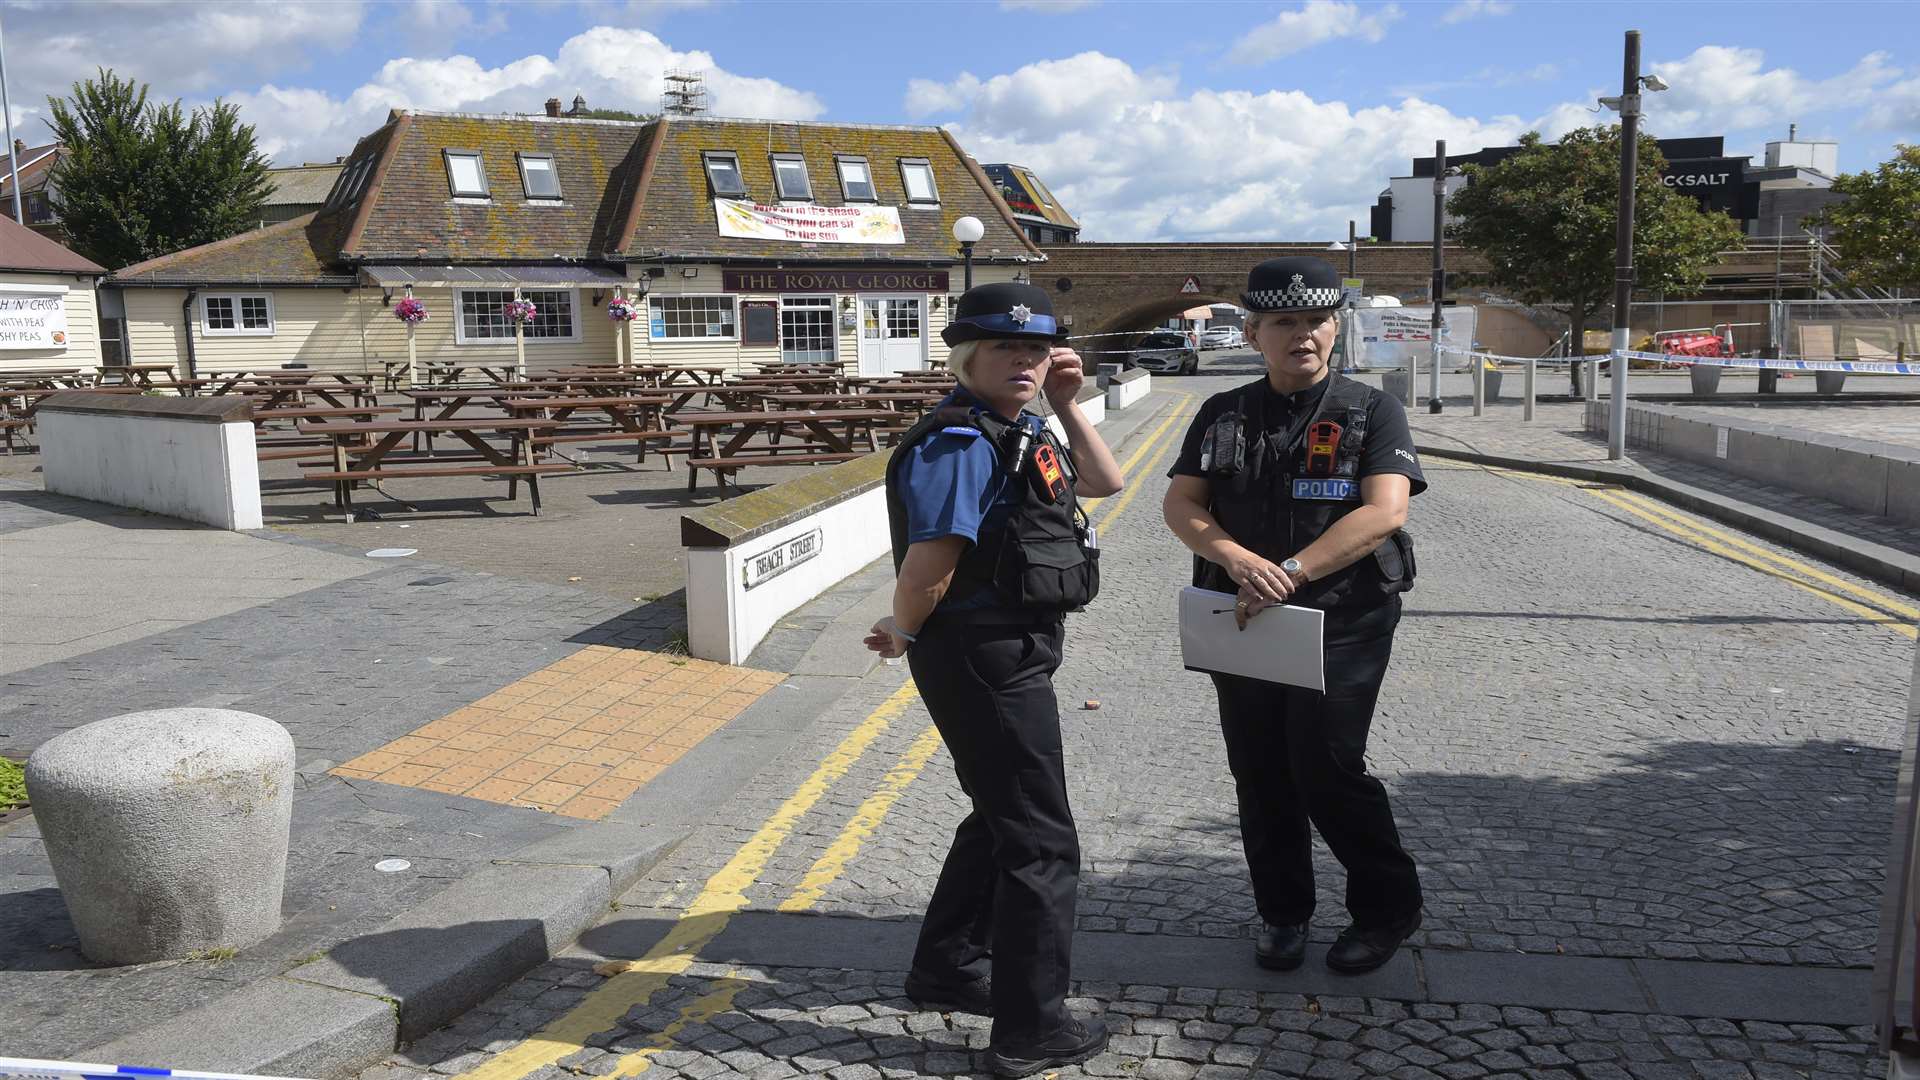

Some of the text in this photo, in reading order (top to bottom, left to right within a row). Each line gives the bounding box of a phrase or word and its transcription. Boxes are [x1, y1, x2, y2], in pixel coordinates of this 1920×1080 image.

[819, 219, 838, 228] can
[819, 231, 839, 241] sun
[737, 275, 938, 289] THE ROYAL GEORGE
[30, 299, 59, 311] CHIPS
[25, 317, 45, 327] PEAS
[19, 331, 42, 342] PEAS
[1298, 481, 1358, 497] POLICE
[756, 534, 816, 577] BEACH STREET
